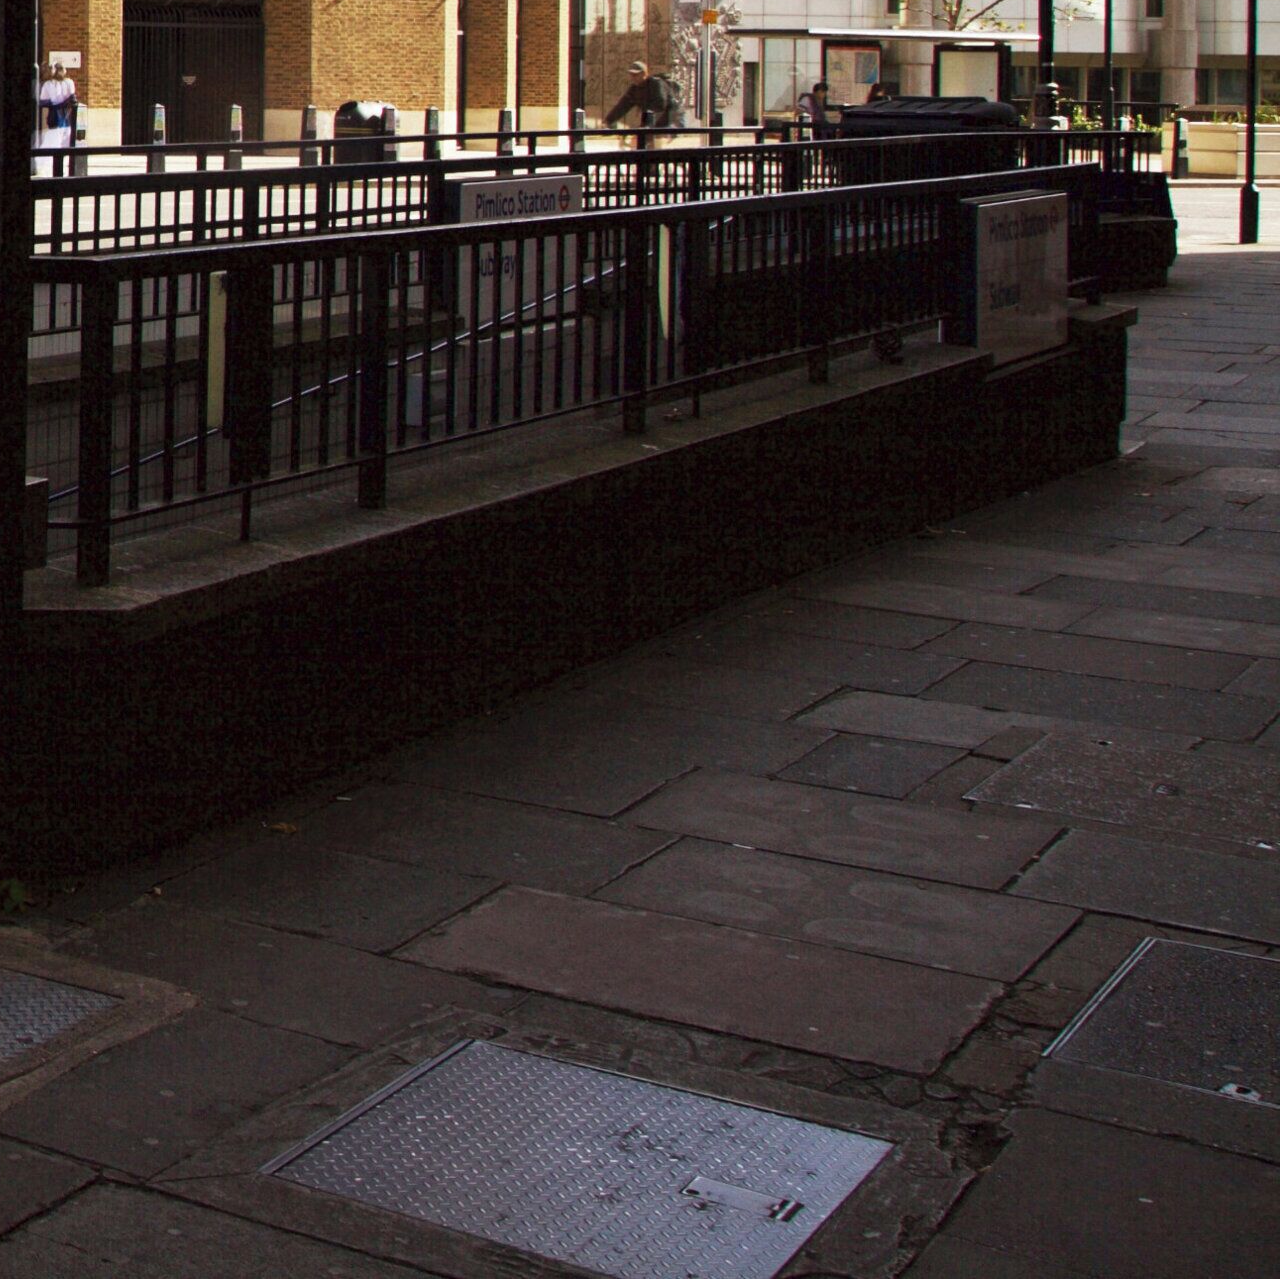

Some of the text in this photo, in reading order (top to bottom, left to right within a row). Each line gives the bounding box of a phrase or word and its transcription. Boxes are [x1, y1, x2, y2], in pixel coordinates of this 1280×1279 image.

[475, 189, 556, 219] Pimlico Station
[481, 251, 515, 279] ubay
